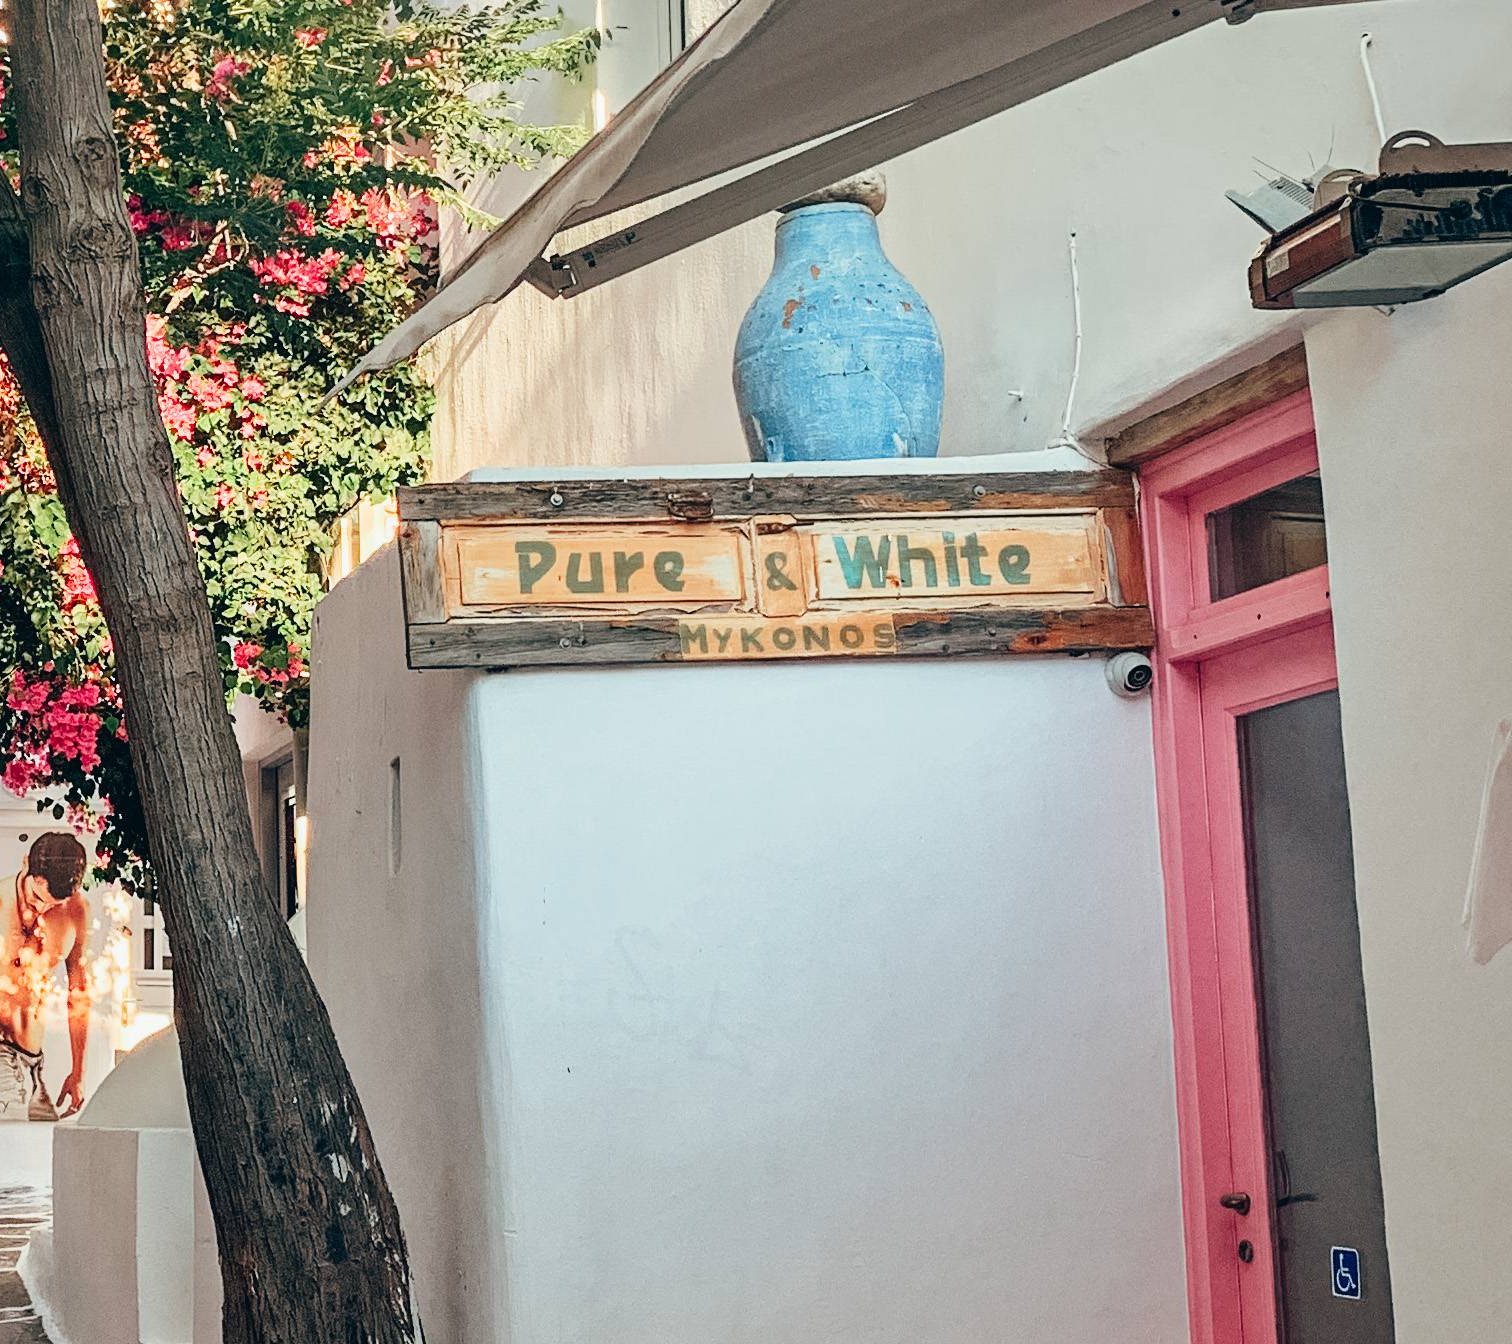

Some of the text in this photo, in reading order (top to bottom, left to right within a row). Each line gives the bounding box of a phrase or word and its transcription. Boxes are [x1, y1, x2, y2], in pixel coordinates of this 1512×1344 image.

[514, 531, 1032, 594] Pure & White
[681, 623, 895, 654] MYKONOS
